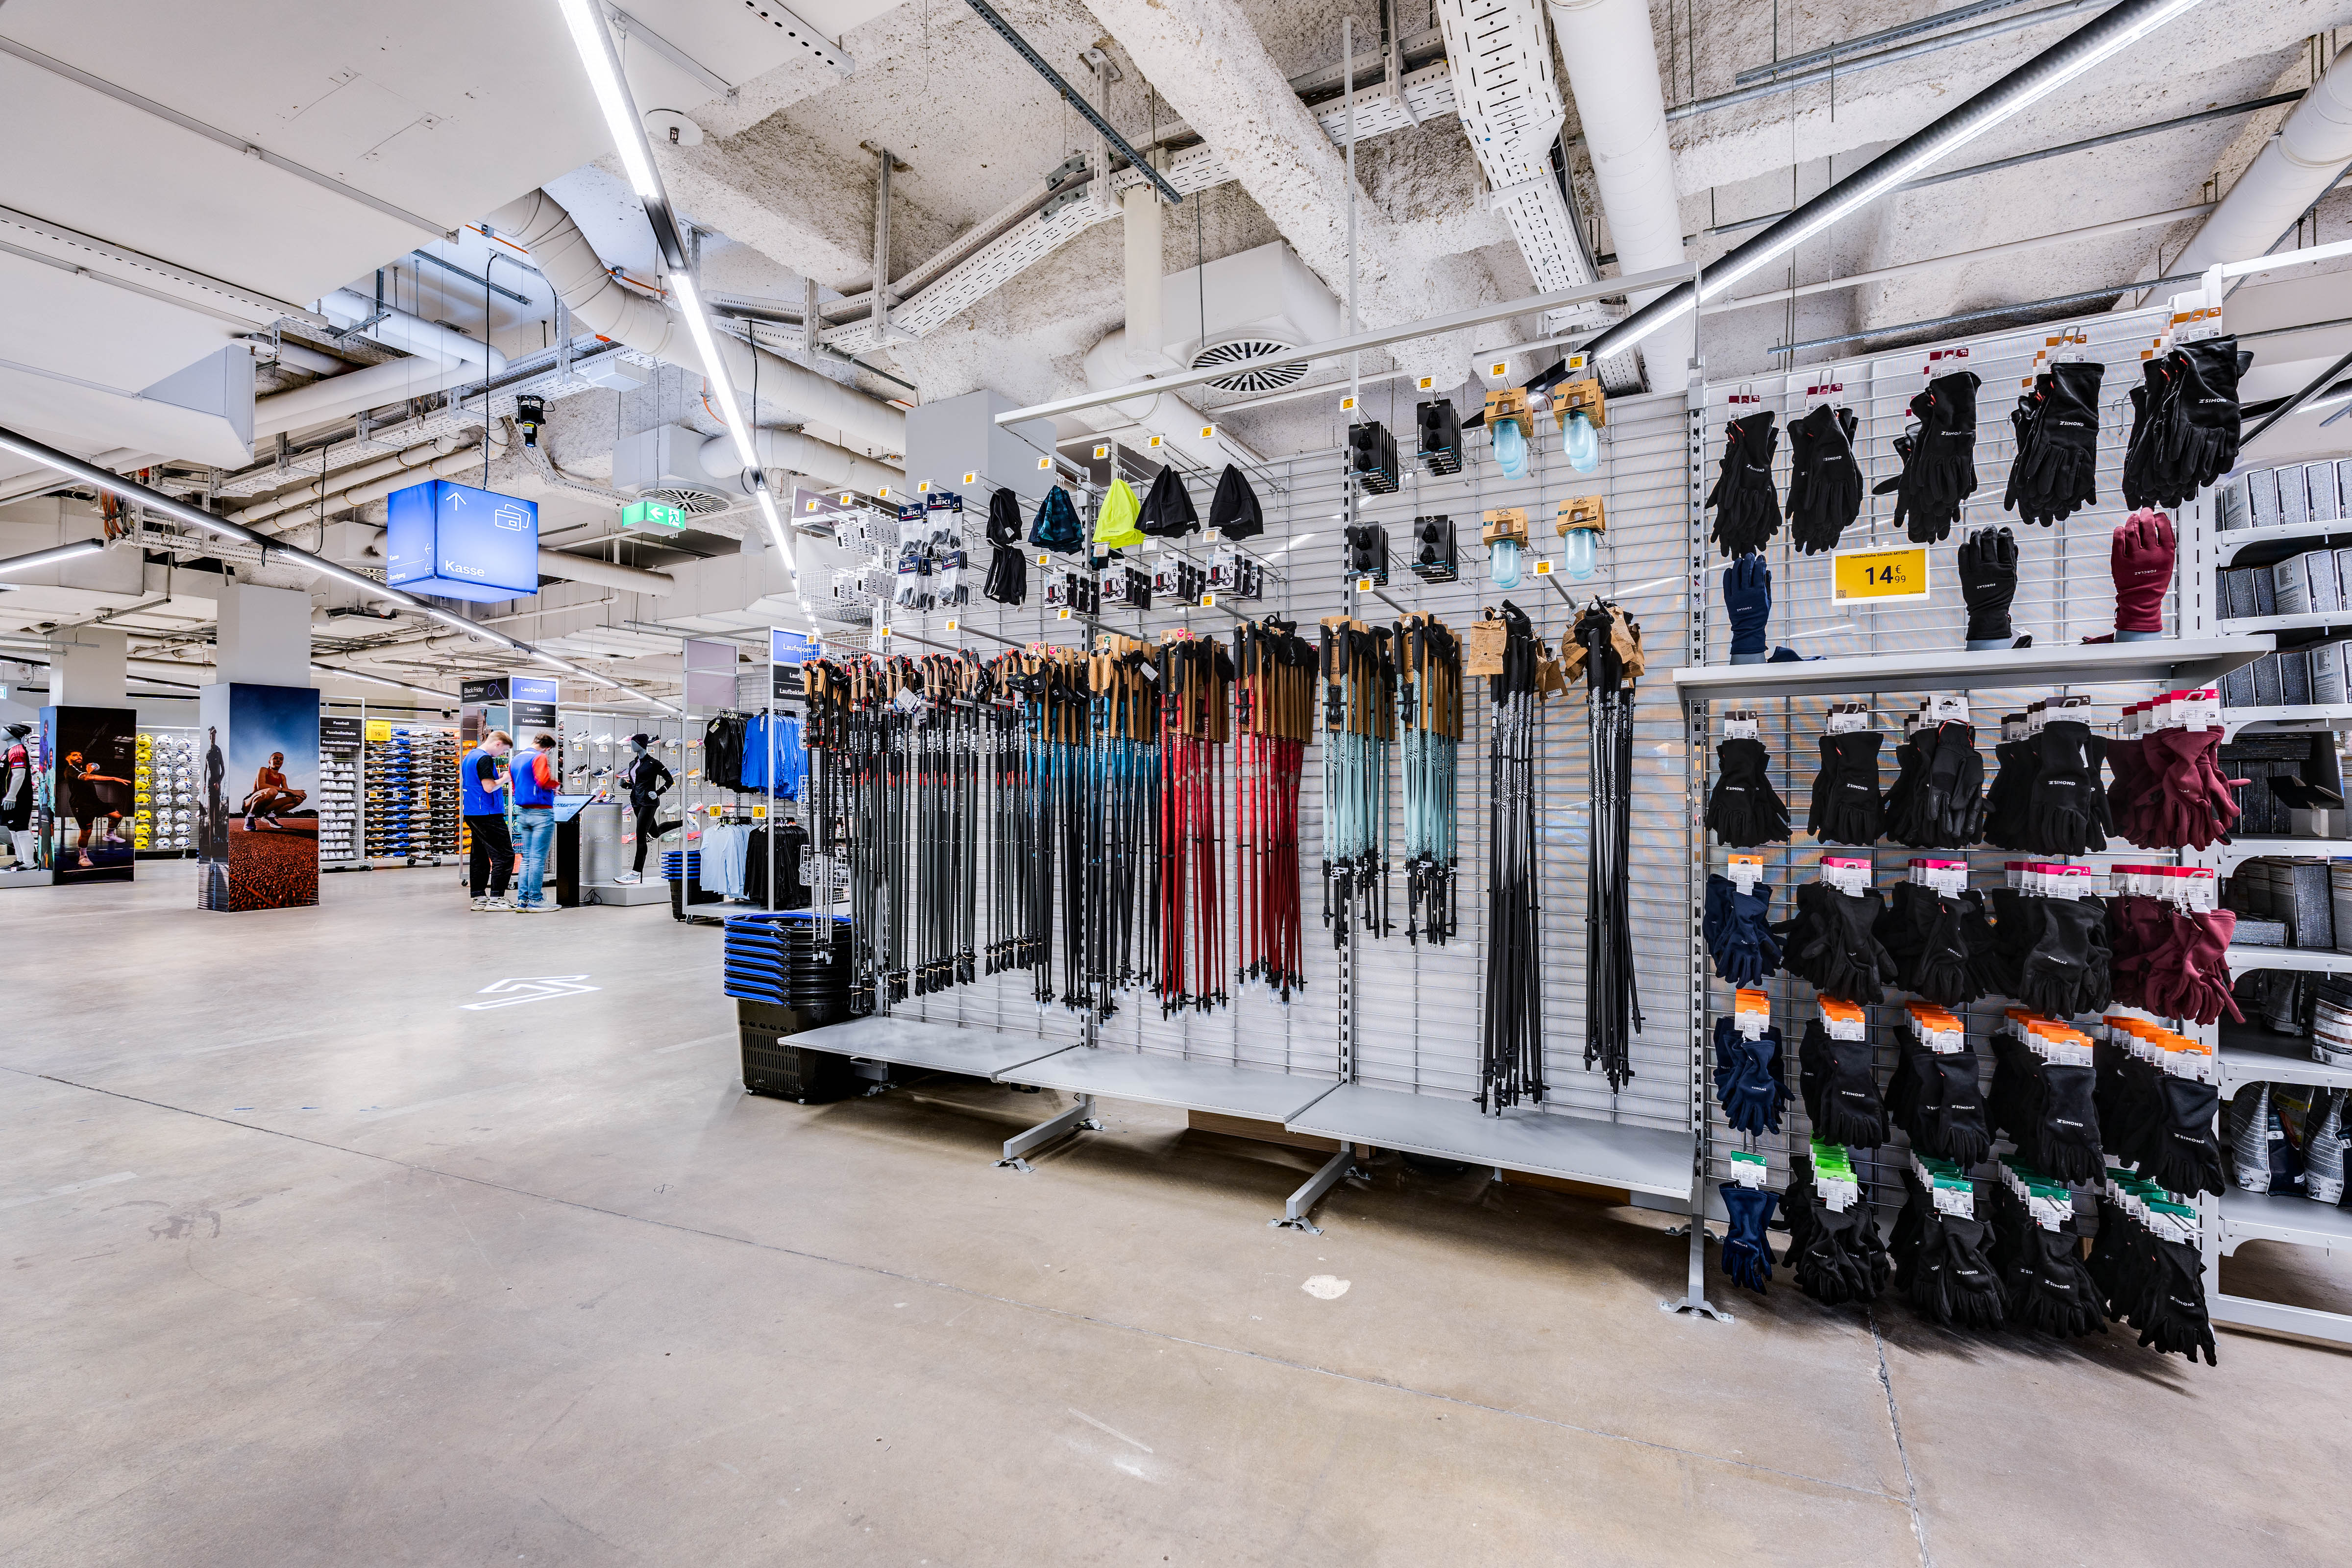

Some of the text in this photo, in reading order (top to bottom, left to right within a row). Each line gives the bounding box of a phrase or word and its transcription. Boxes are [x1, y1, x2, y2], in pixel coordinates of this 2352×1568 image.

[445, 560, 485, 577] Kasse
[1895, 564, 1901, 574] €
[1865, 565, 1893, 585] 14
[1947, 948, 1962, 958] FORCLAZ
[2048, 956, 2067, 965] FORCLAZ
[2180, 1135, 2205, 1144] SIMOND
